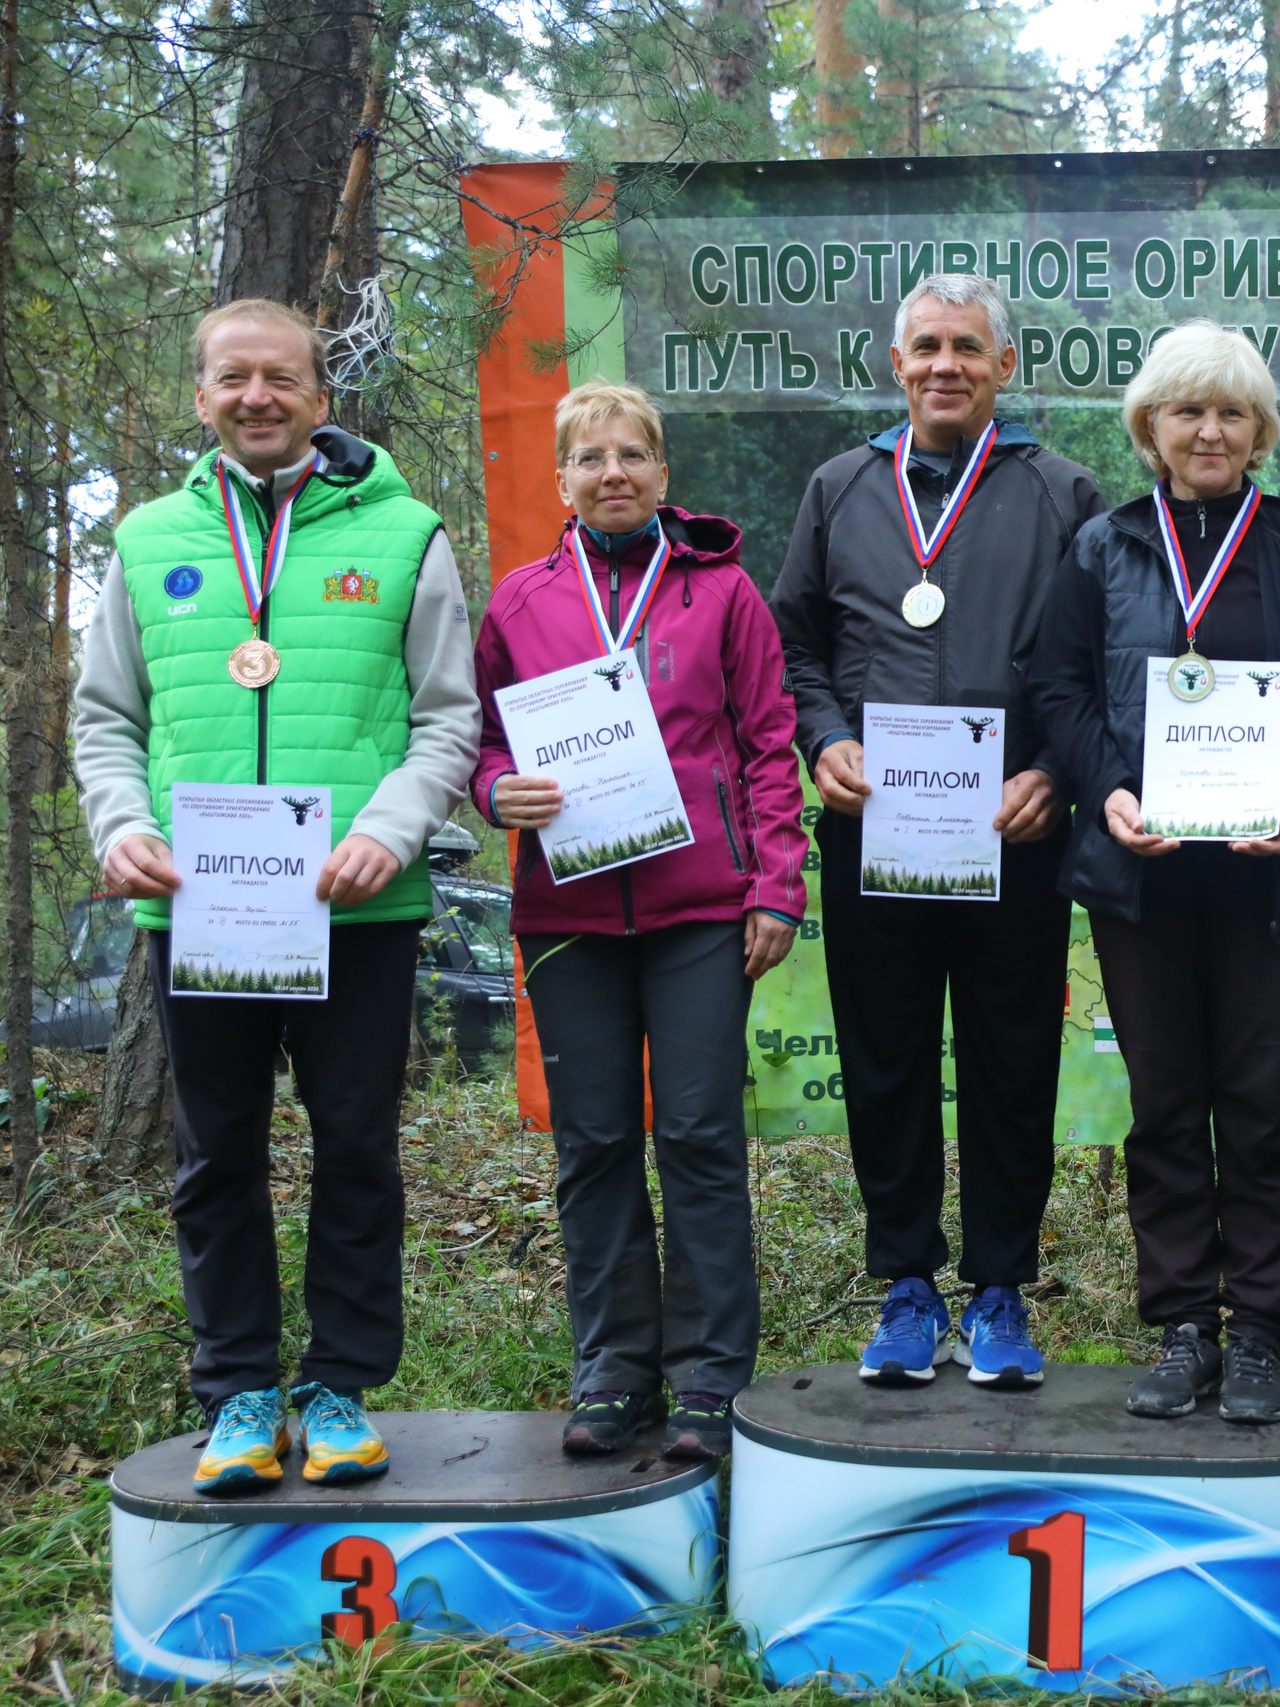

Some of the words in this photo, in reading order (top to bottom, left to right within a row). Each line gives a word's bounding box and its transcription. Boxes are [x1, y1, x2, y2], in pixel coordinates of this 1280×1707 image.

[691, 240, 1109, 305] СПОРТИВНОЕ
[664, 331, 817, 391] ПУТЬ
[840, 330, 874, 388] К
[535, 720, 635, 767] ДИПЛОМ
[1166, 725, 1265, 743] ДИПЛОМ
[573, 752, 607, 766] НАГРАЖДАЕТСЯ
[883, 769, 980, 789] ДИПЛОМ
[195, 854, 304, 877] ДИПЛОМ
[321, 1535, 399, 1660] 3
[1007, 1510, 1086, 1672] 1
